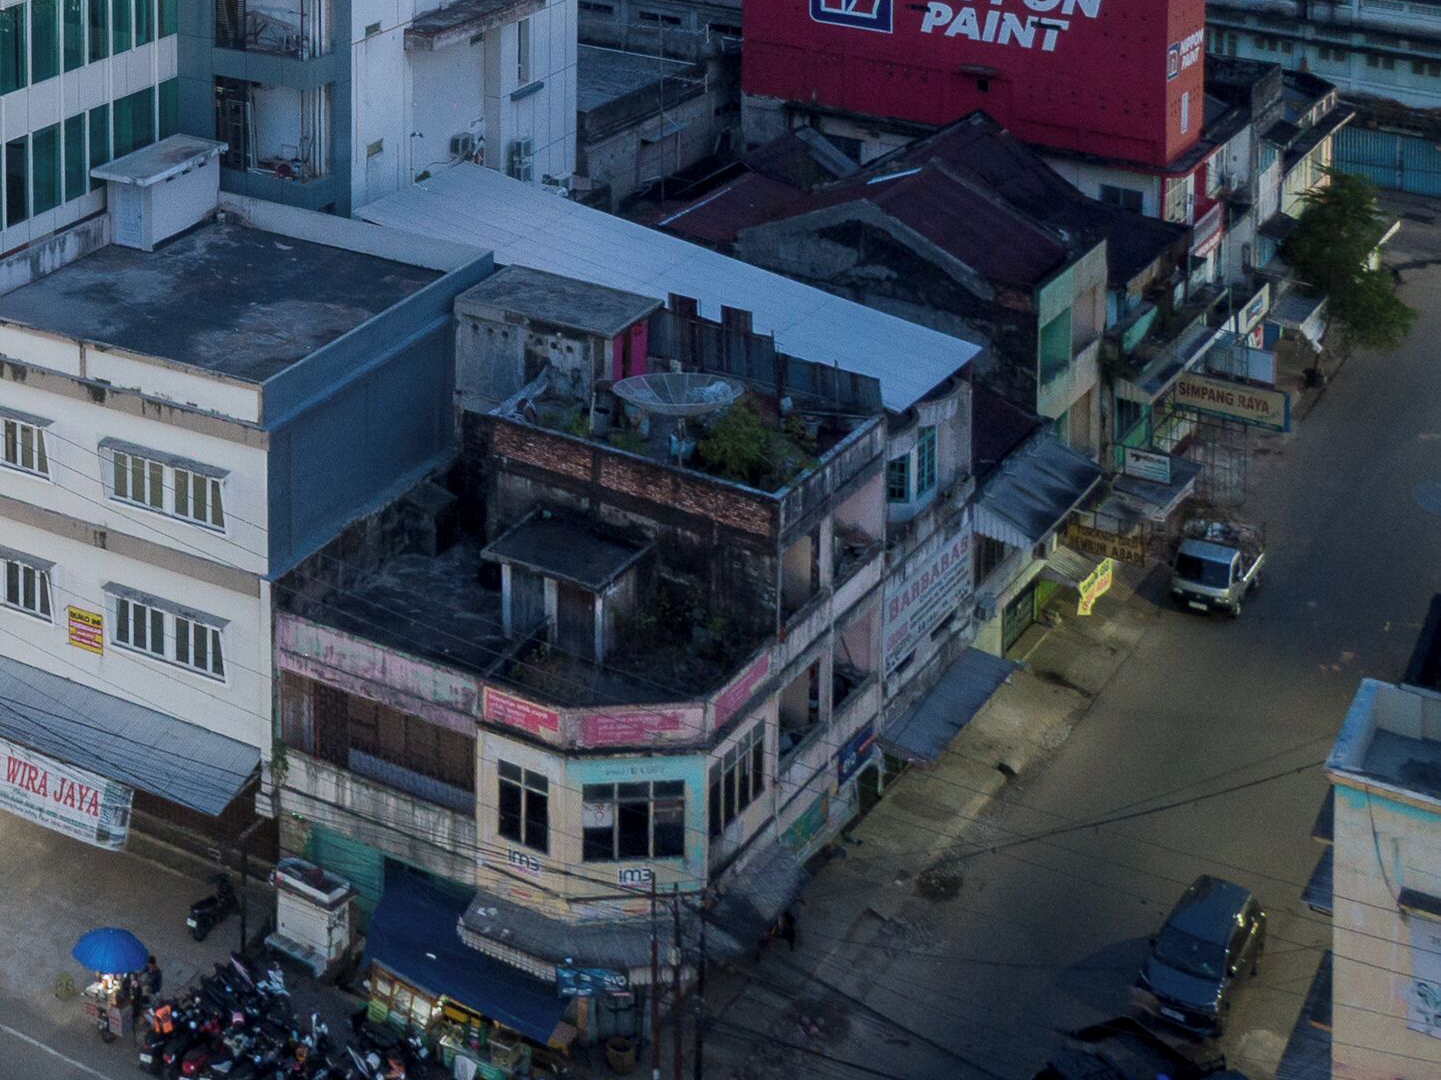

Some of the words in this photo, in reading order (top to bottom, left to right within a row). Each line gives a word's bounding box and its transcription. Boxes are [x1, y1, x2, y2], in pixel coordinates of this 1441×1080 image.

[920, 1, 1070, 52] PAINT
[1179, 27, 1205, 56] NIPPON
[1178, 381, 1234, 406] SIMPANG
[1238, 393, 1270, 414] RAYA
[6, 756, 48, 798] WIRA
[53, 777, 100, 817] JAYA
